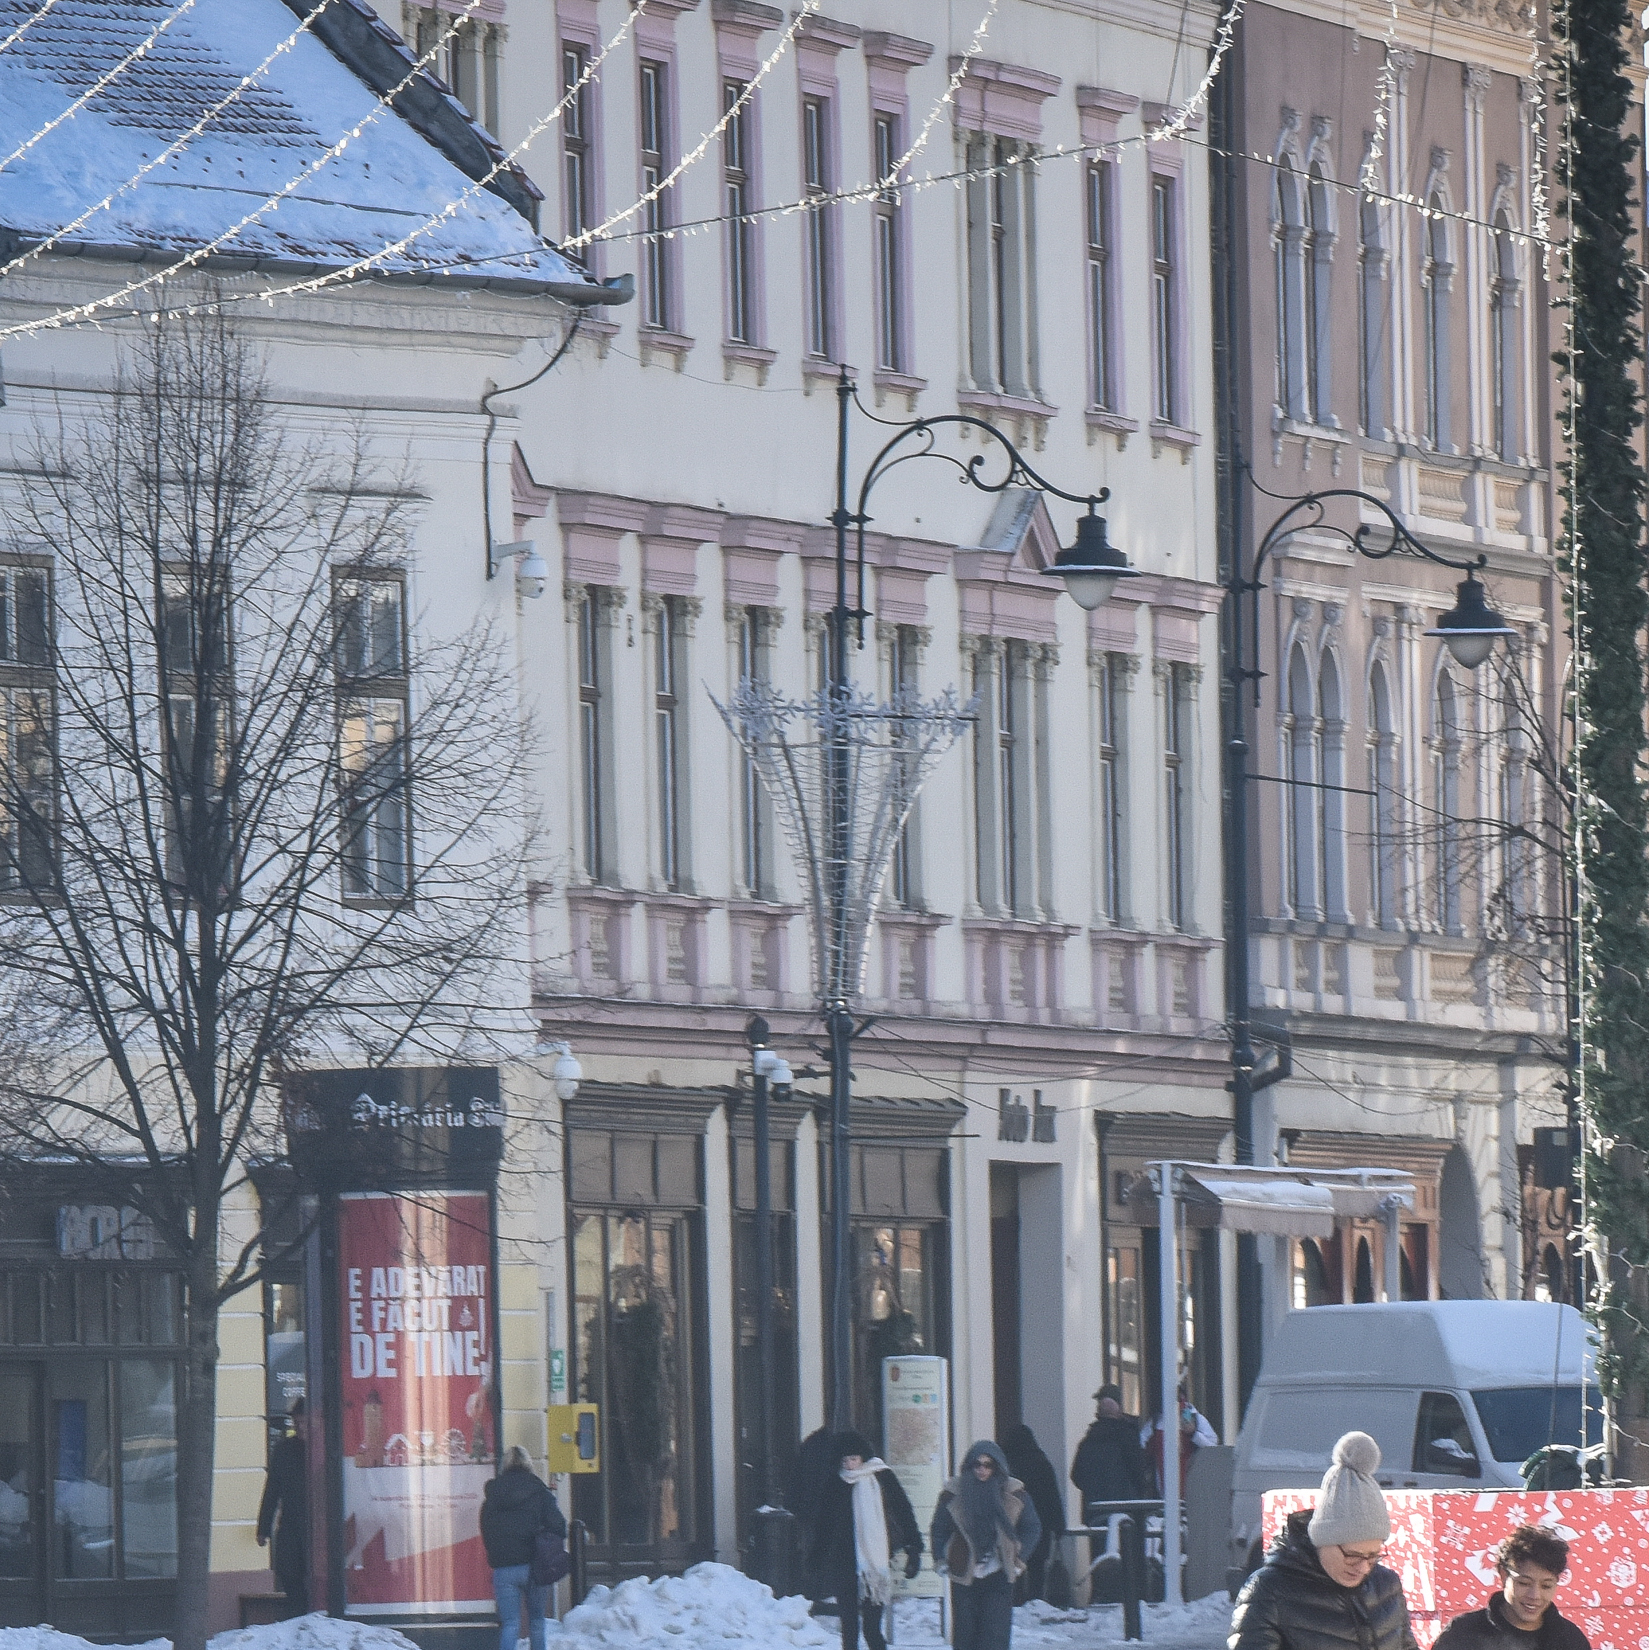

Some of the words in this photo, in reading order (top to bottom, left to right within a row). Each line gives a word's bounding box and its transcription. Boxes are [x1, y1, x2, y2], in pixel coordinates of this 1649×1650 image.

[348, 1267, 363, 1299] E
[370, 1265, 487, 1298] ADEVĂRAT
[350, 1301, 365, 1333] E
[371, 1298, 452, 1332] FĂCUT
[351, 1332, 398, 1379] DE
